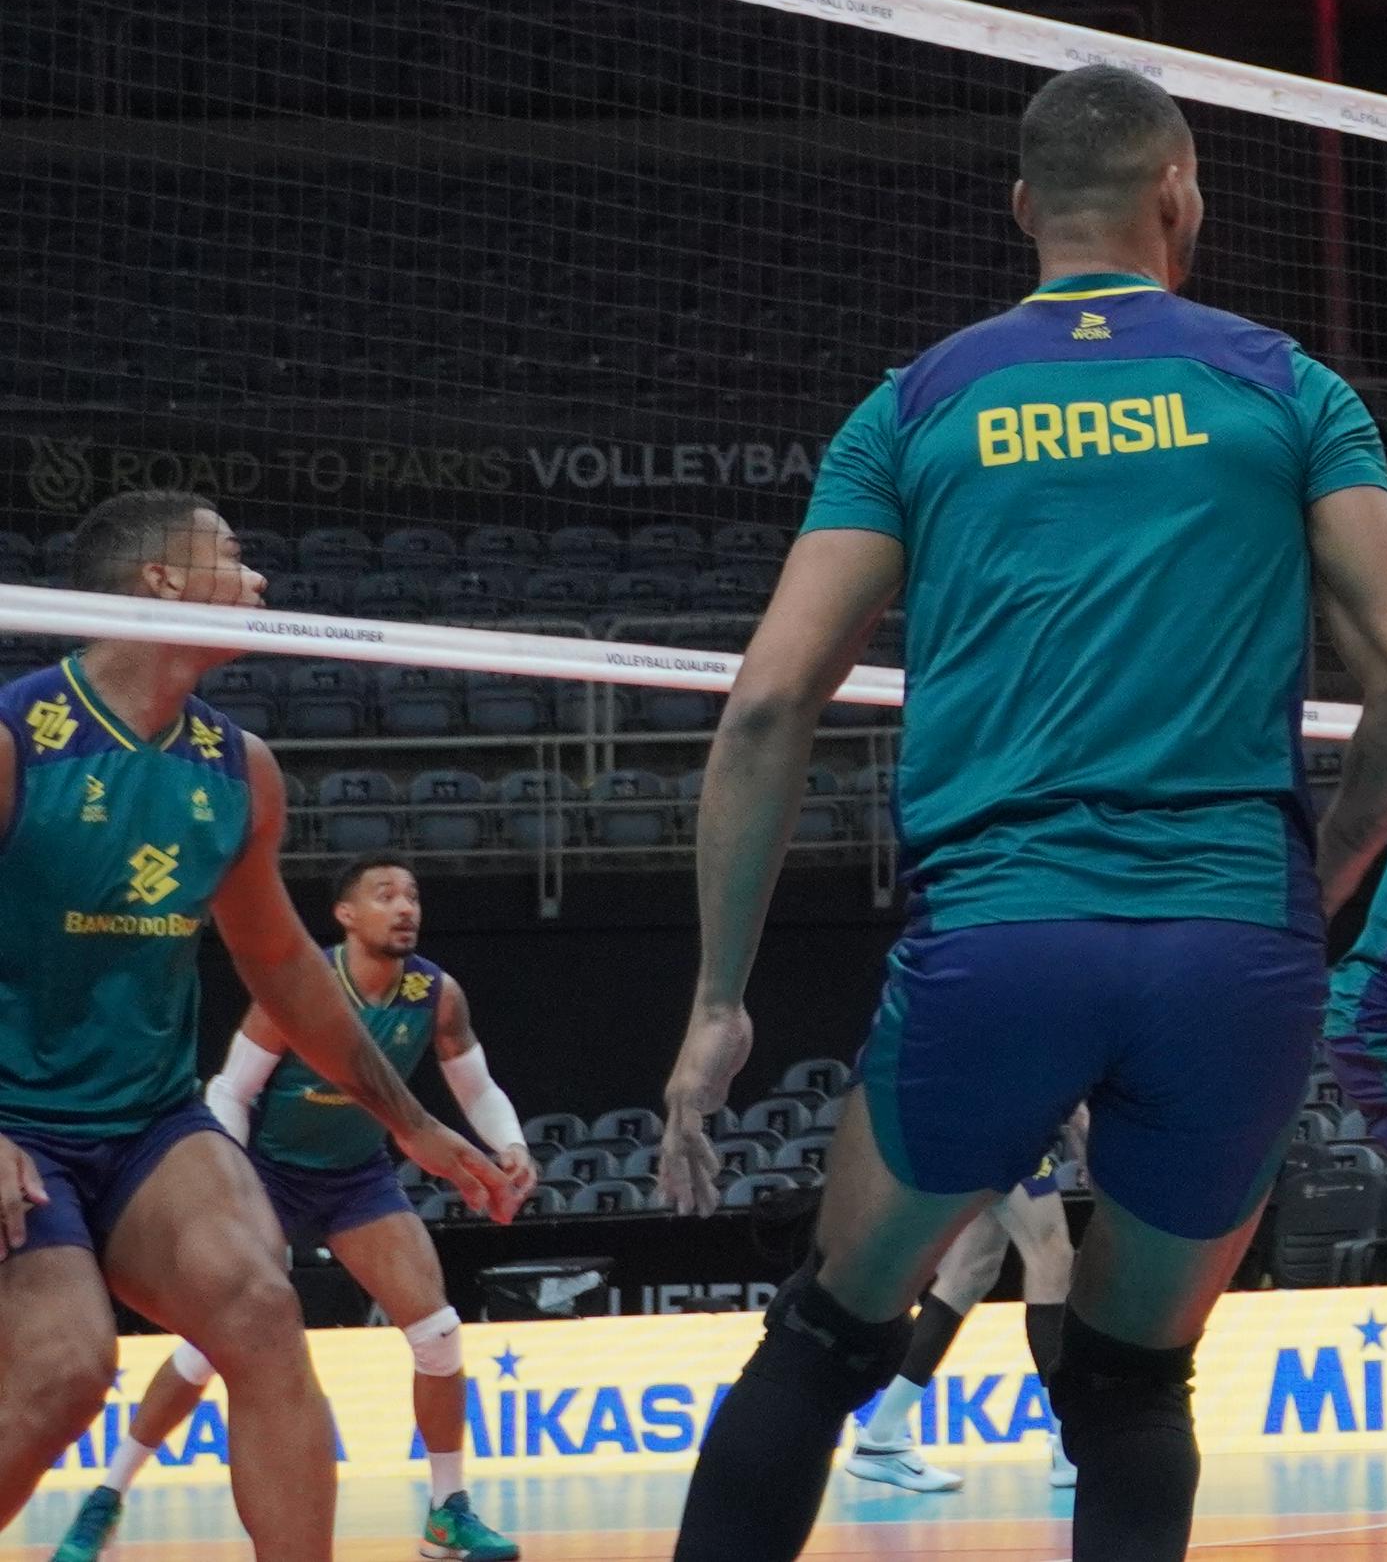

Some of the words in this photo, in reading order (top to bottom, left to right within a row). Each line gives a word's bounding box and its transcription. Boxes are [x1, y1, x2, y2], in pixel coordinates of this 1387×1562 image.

[977, 392, 1210, 468] BRASIL
[111, 450, 261, 495] ROAD
[279, 449, 348, 494] TO
[364, 446, 512, 492] PARIS
[526, 442, 824, 488] VOLLEYBA
[247, 619, 320, 638] VOLLEYBALL
[325, 625, 385, 643] QUALIFIER
[606, 652, 672, 670] VOLLEYBALL
[674, 658, 728, 673] QUALIFIER
